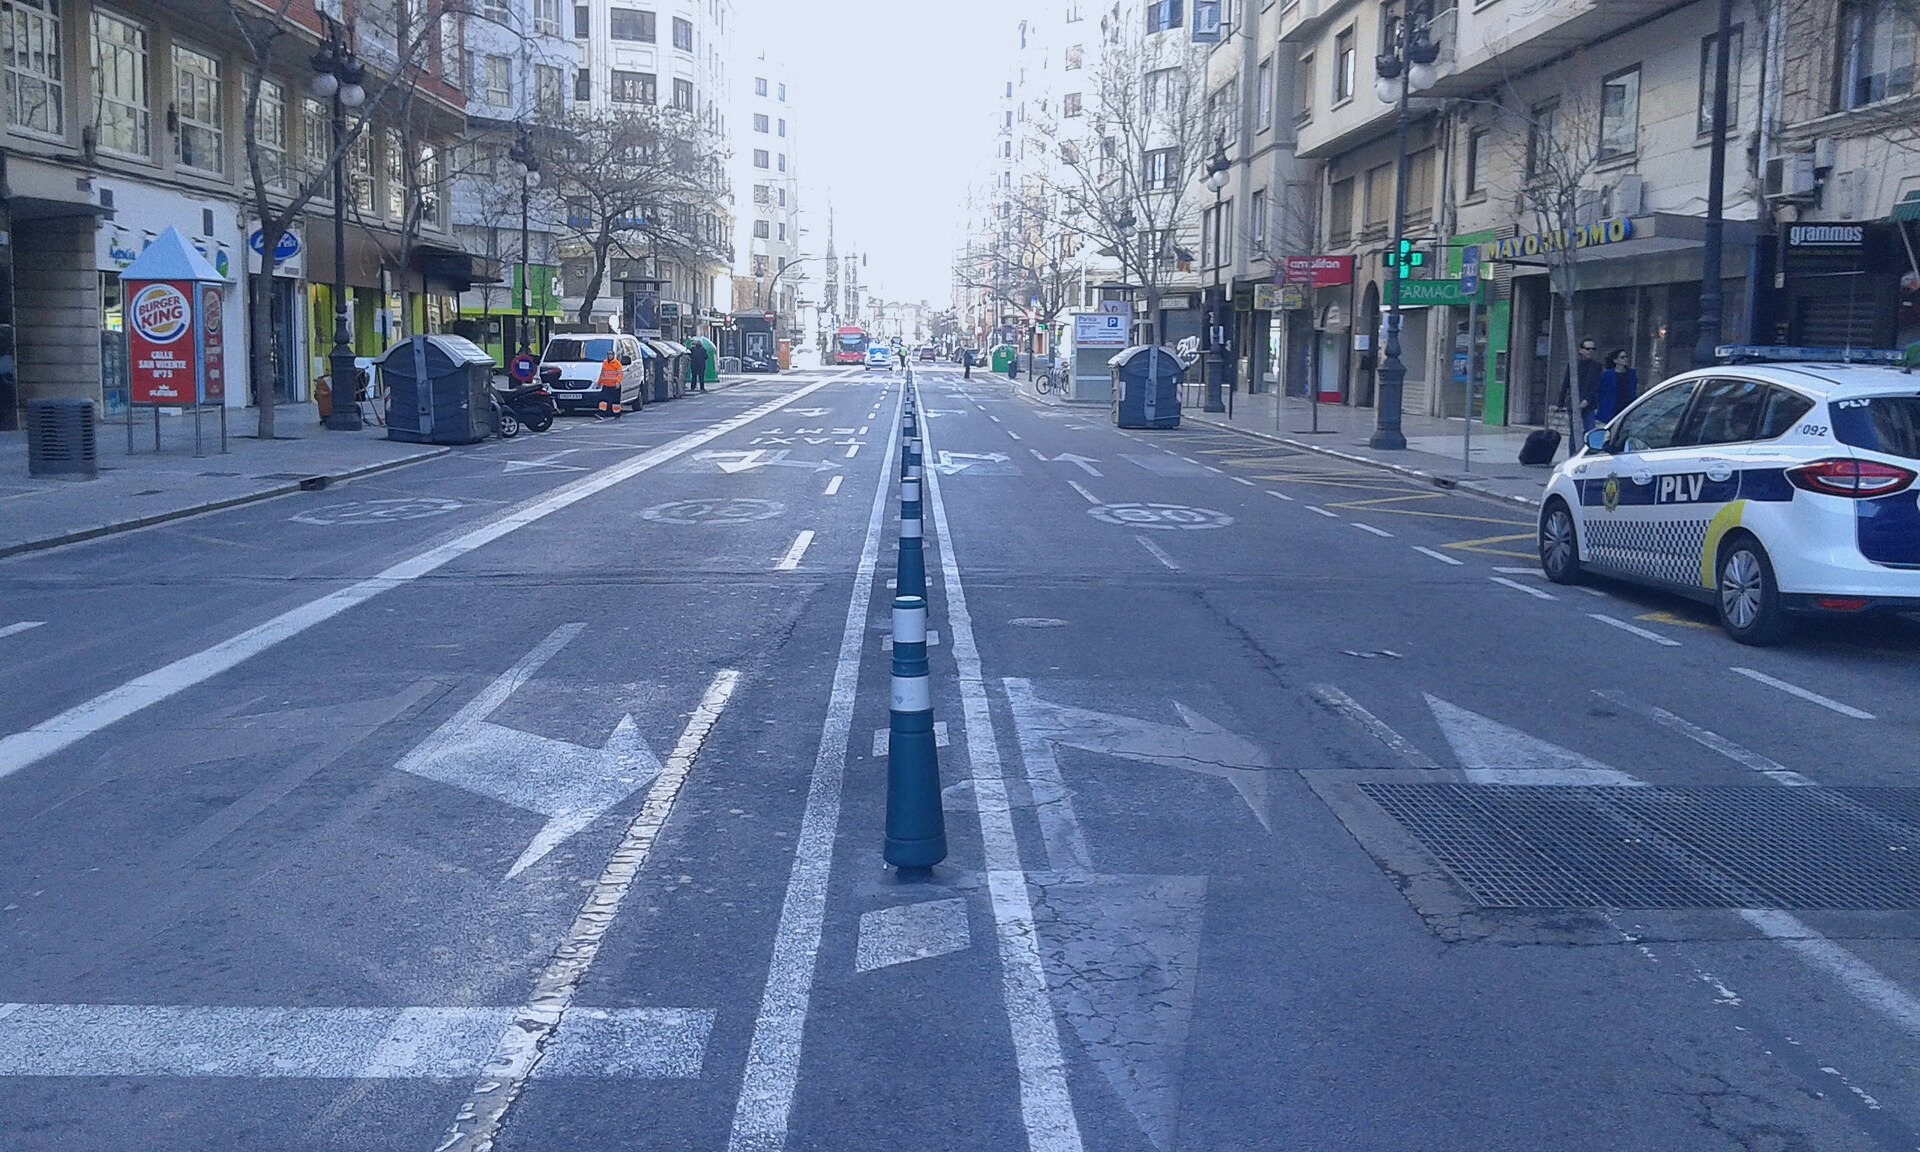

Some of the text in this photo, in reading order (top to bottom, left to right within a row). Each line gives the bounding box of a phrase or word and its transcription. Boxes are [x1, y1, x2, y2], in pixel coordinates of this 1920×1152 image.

[1790, 226, 1864, 246] grammos
[1400, 284, 1463, 299] FARMACI
[139, 296, 181, 316] BURGER
[140, 306, 183, 330] KING
[151, 351, 174, 360] CALLE
[1838, 398, 1871, 410] PLV
[1802, 424, 1828, 437] 092
[748, 437, 867, 445] TAXI
[1660, 474, 1705, 502] PLV
